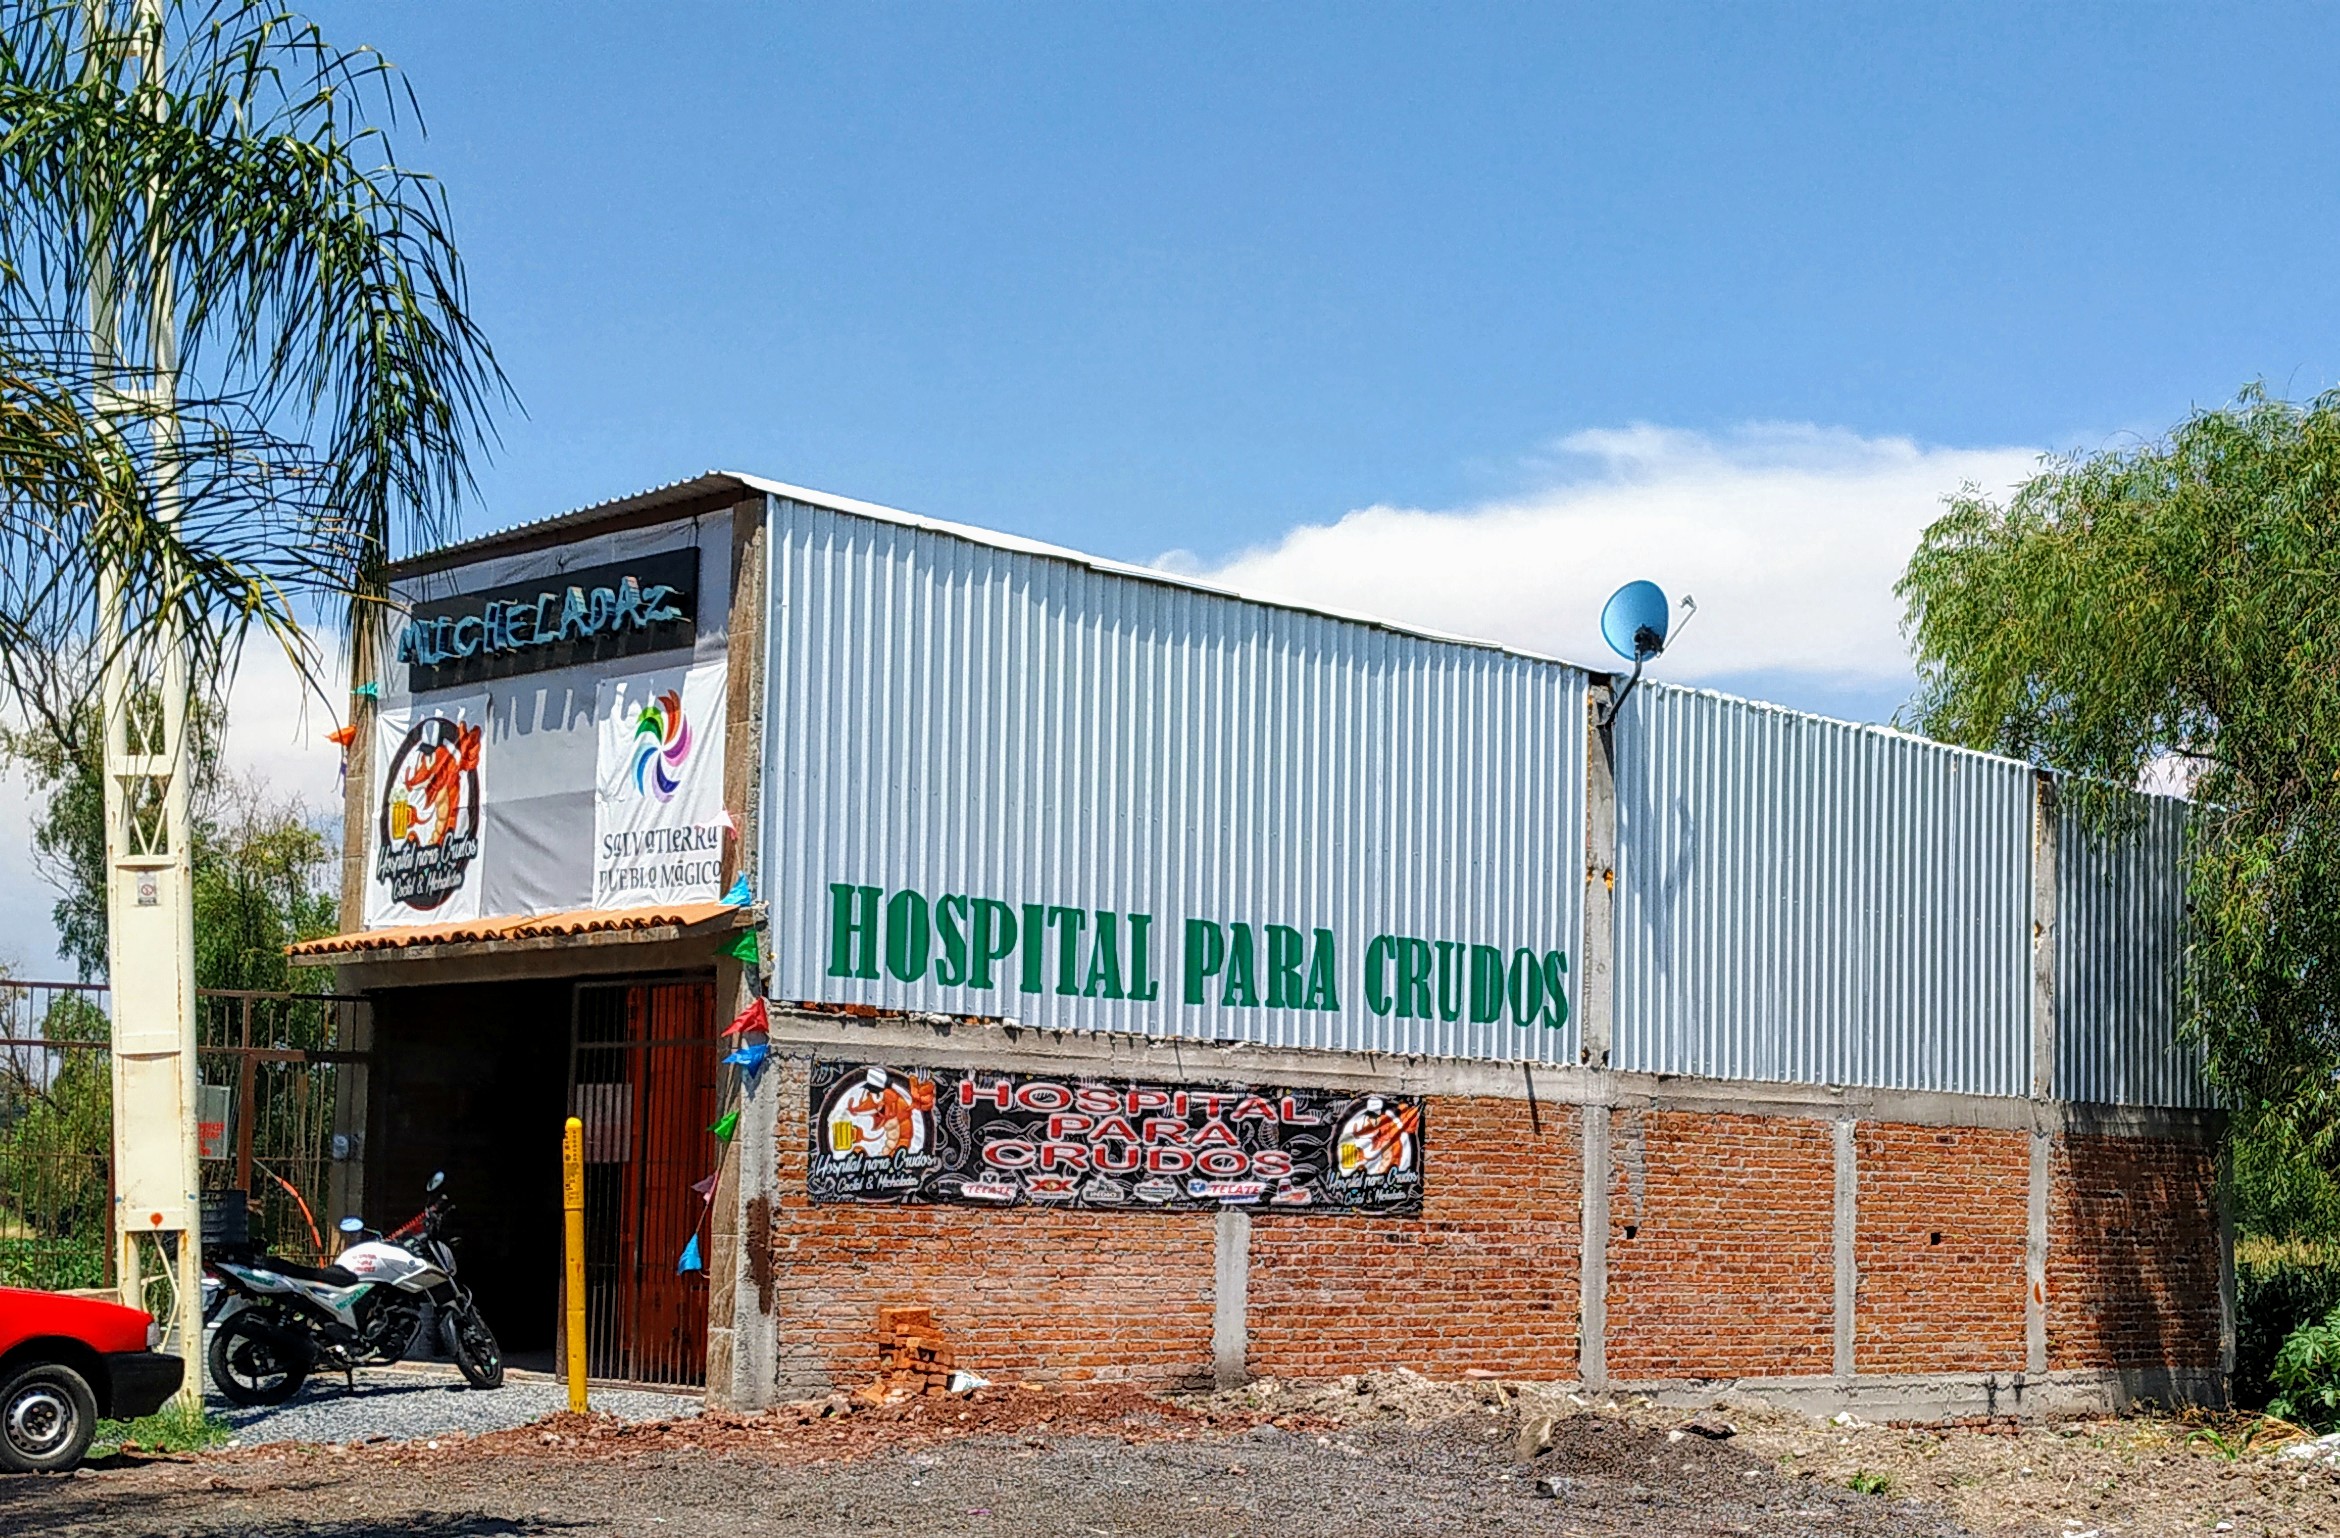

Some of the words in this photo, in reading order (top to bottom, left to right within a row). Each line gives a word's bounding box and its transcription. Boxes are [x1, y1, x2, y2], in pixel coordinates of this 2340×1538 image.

[828, 883, 1158, 1001] HOSPITAL
[1184, 918, 1339, 1012] PARA
[1365, 934, 1568, 1030] CRUDOS
[959, 1079, 1321, 1125] HOSPITAL
[1049, 1113, 1241, 1149] PARA
[816, 1153, 863, 1178] Hospital
[862, 1157, 891, 1175] para
[894, 1149, 935, 1170] Crudos
[982, 1139, 1295, 1177] CRUDOS
[866, 1175, 874, 1190] &
[966, 1184, 1014, 1197] TECATE
[1211, 1183, 1262, 1195] TECATE
